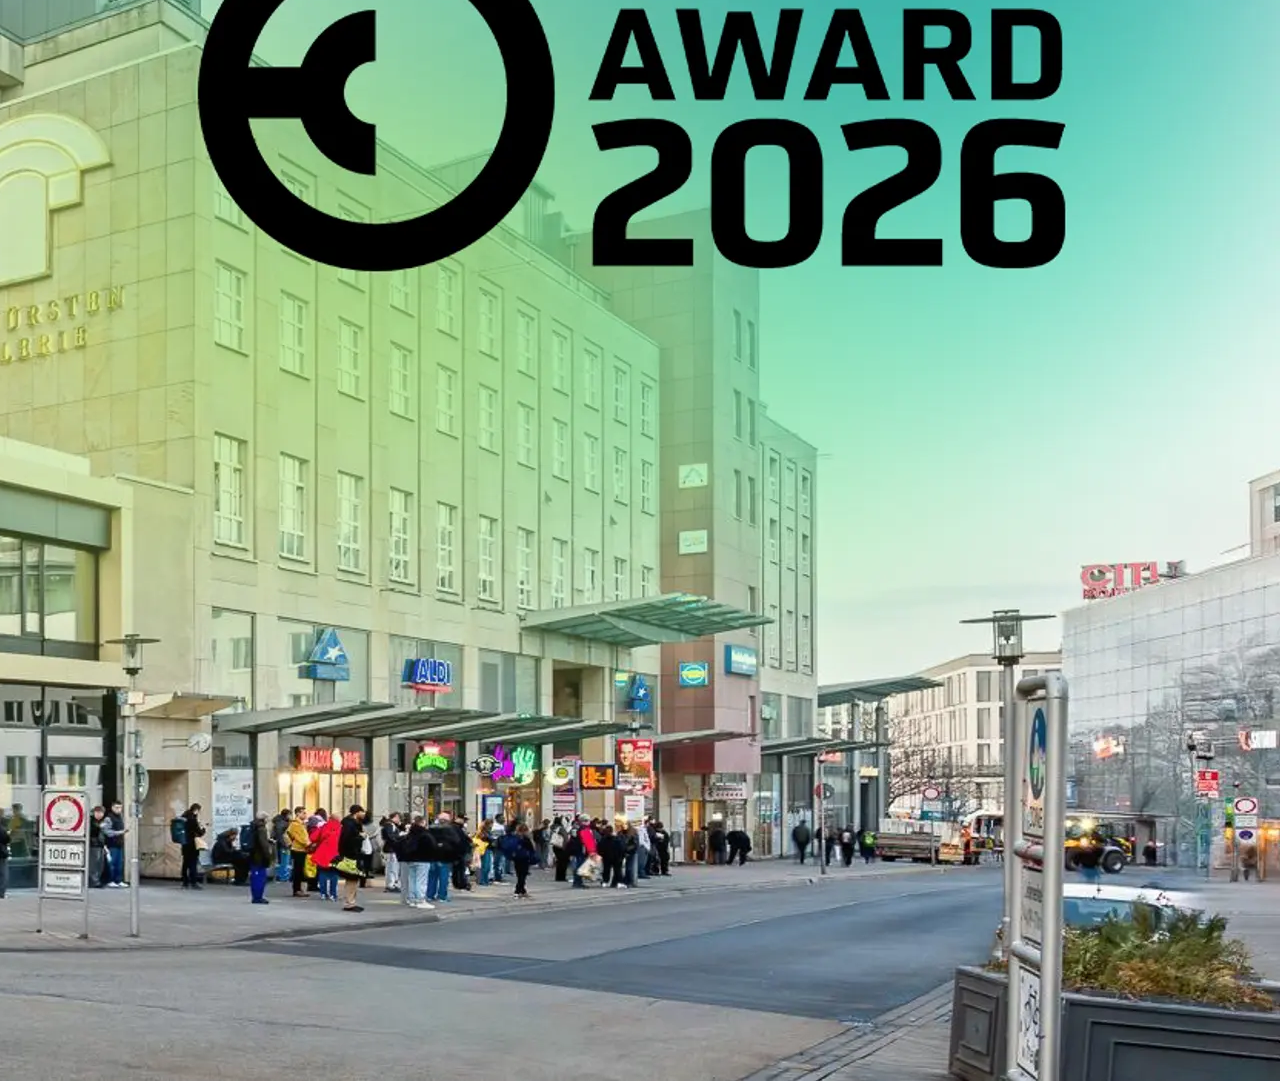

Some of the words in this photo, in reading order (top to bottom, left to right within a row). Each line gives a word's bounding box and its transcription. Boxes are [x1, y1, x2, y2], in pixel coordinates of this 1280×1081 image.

[416, 658, 454, 685] ALDI
[49, 848, 67, 860] 100
[70, 850, 80, 860] m
